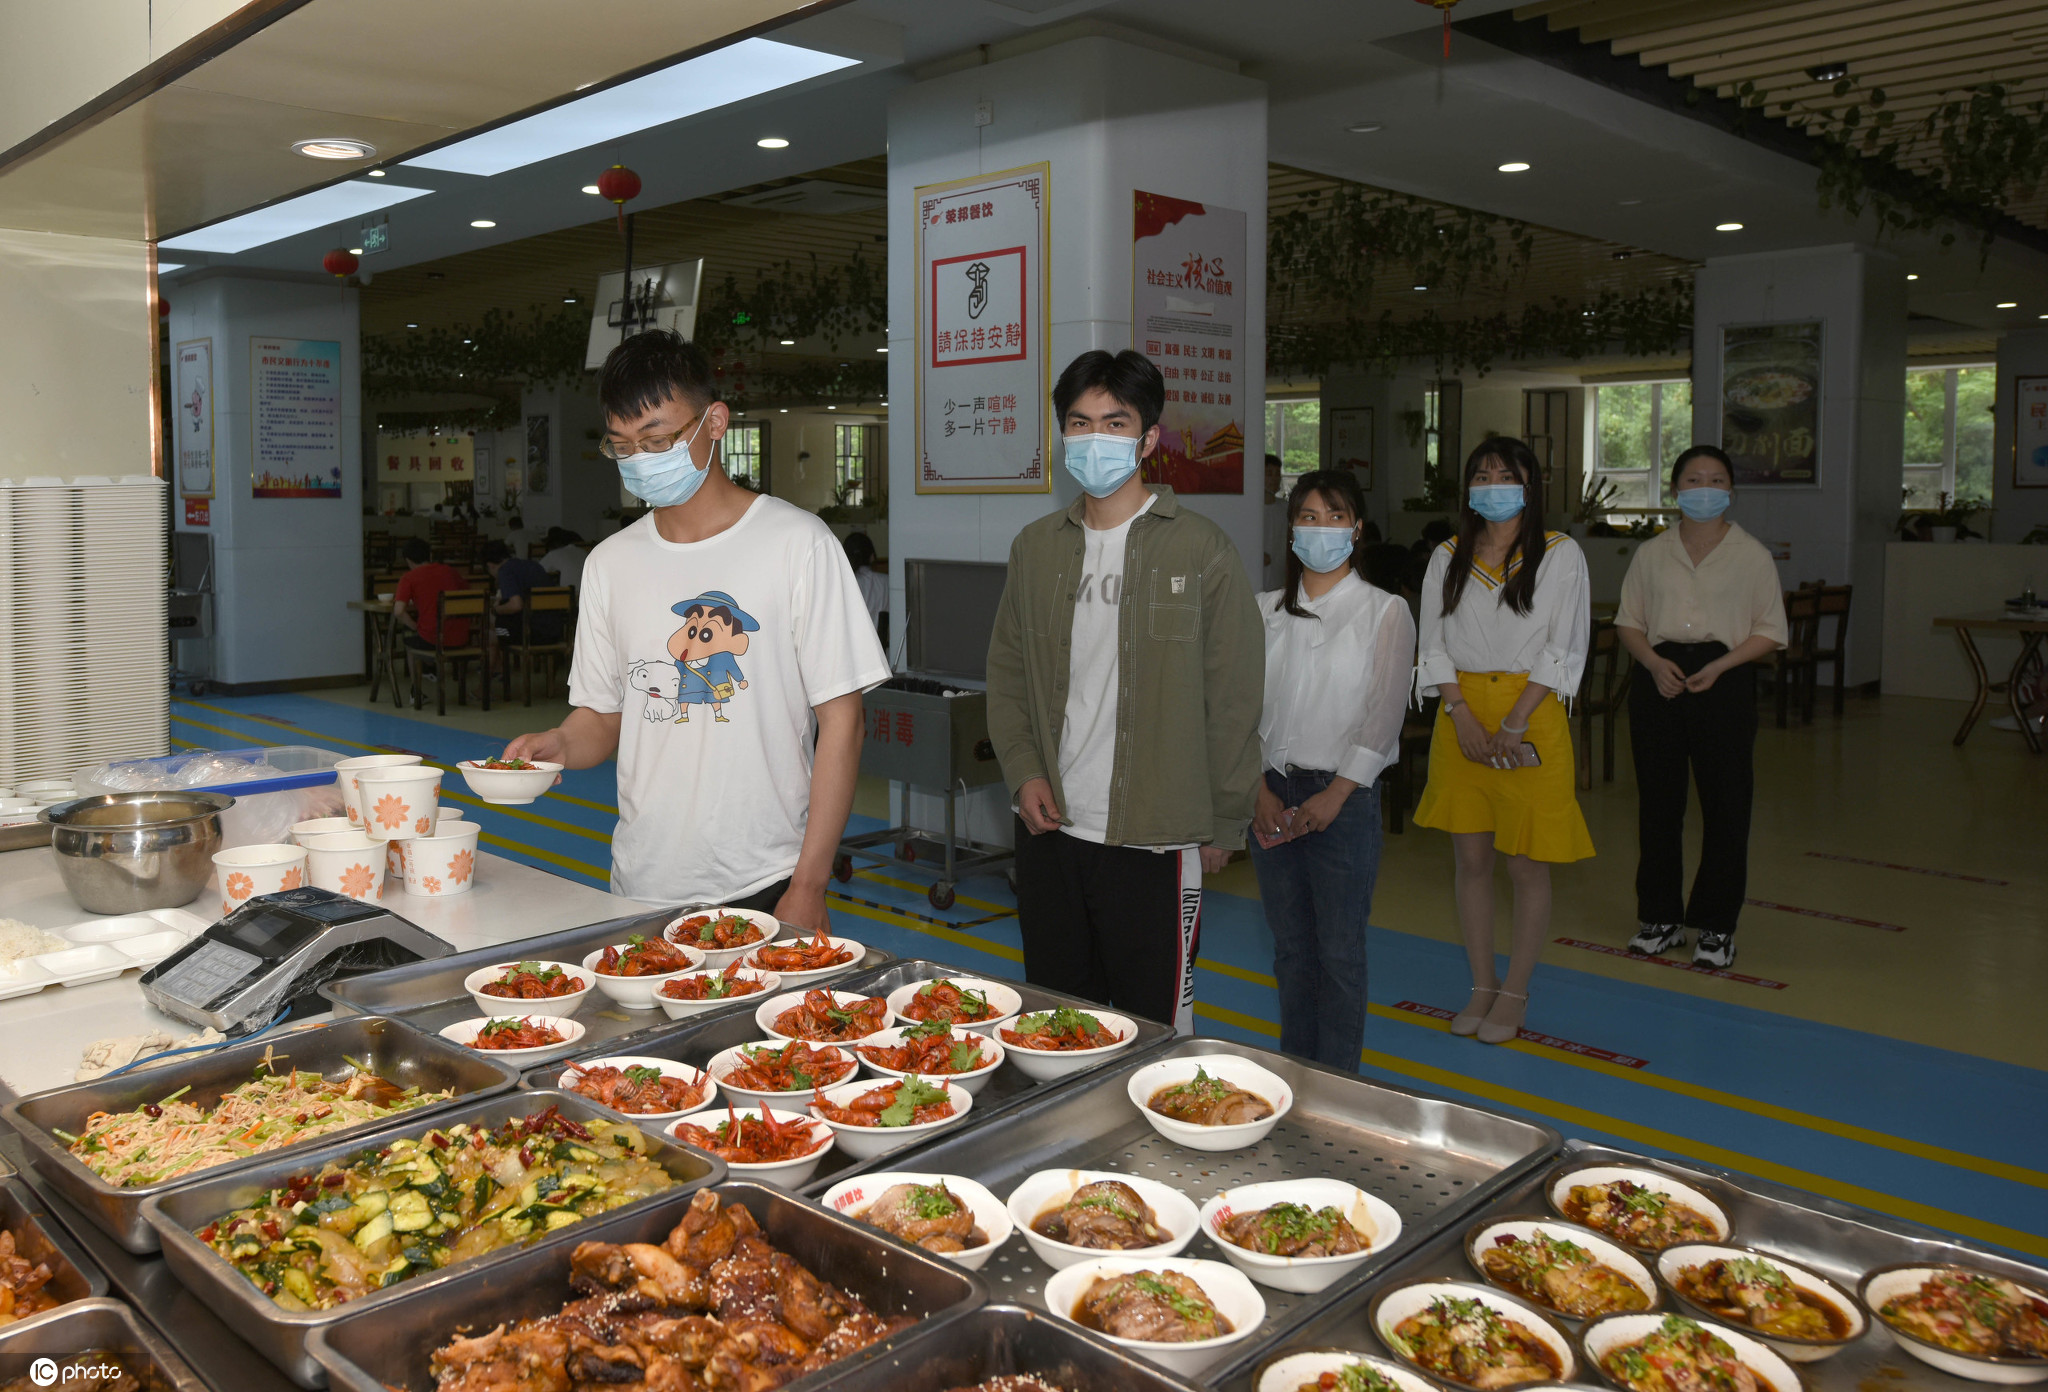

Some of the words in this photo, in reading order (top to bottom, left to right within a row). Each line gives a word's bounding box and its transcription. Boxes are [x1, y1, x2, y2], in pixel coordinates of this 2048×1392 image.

[946, 201, 993, 224] 荣邦餐饮
[1165, 343, 1179, 356] 富强
[1183, 345, 1197, 357] 民主
[1201, 347, 1215, 359] 文明
[1218, 349, 1231, 361] 和谐
[1165, 366, 1179, 379] 自由
[1183, 368, 1197, 380] 平等
[1201, 370, 1214, 382] 公正
[1218, 371, 1231, 383] 法治
[944, 394, 1017, 416] 少一声喧哗
[1183, 391, 1197, 403] 敬业
[1201, 392, 1214, 404] 诚信
[1218, 393, 1231, 406] 友善
[944, 416, 1017, 438] 多一片宁静
[387, 455, 465, 472] 餐具回收
[862, 708, 914, 747] 消毒
